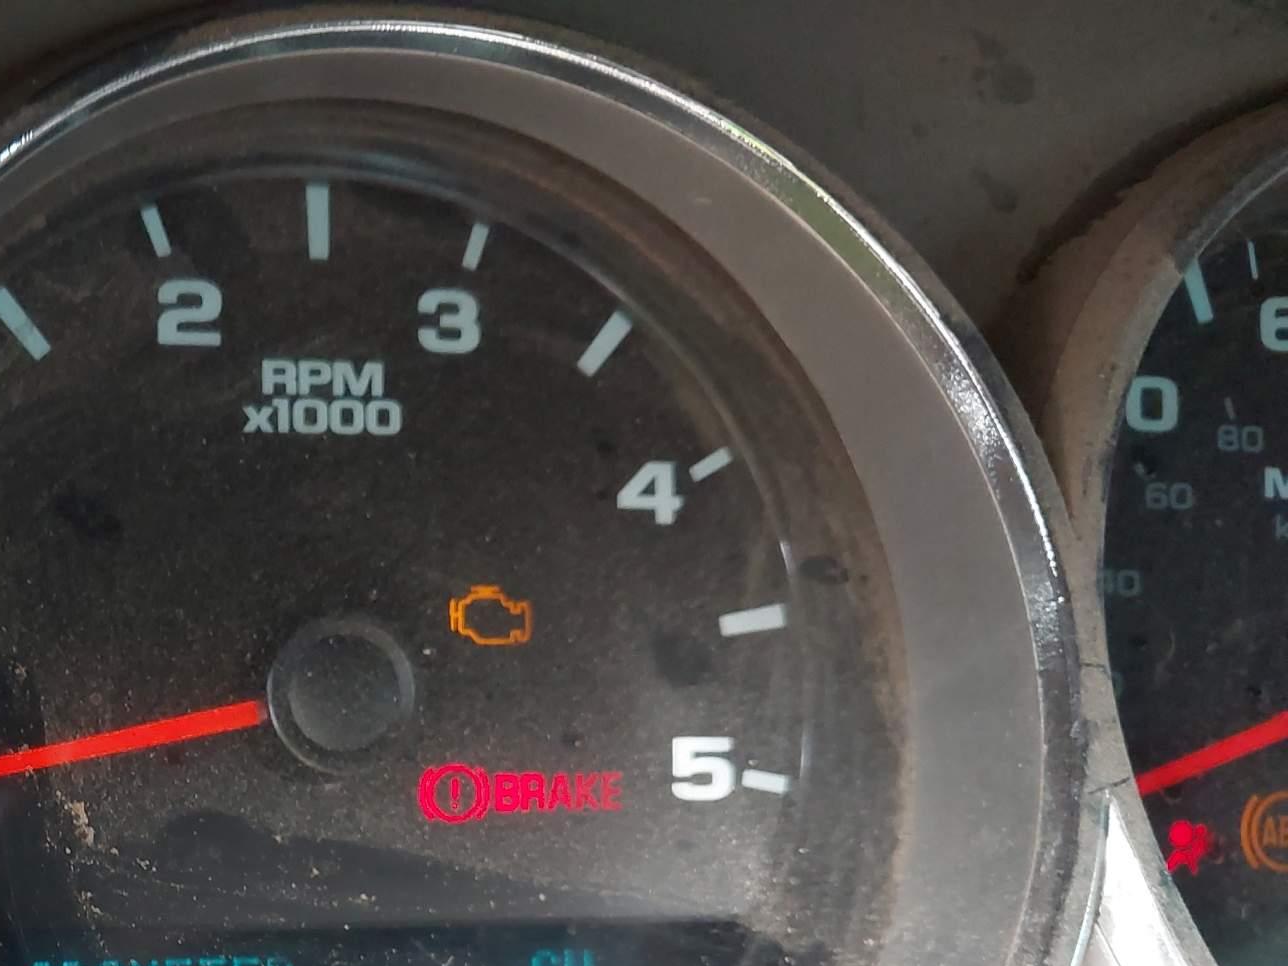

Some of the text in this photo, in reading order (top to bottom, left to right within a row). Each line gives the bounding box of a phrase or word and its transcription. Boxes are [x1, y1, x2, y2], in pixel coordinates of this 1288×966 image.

[157, 279, 223, 347] 2
[417, 289, 482, 354] 3
[262, 360, 385, 397] RPM
[243, 398, 403, 435] x1000
[1217, 425, 1264, 452] 80
[616, 460, 684, 525] 4
[1145, 482, 1194, 510] 60
[671, 736, 736, 801] 5
[494, 772, 623, 813] BRAKE
